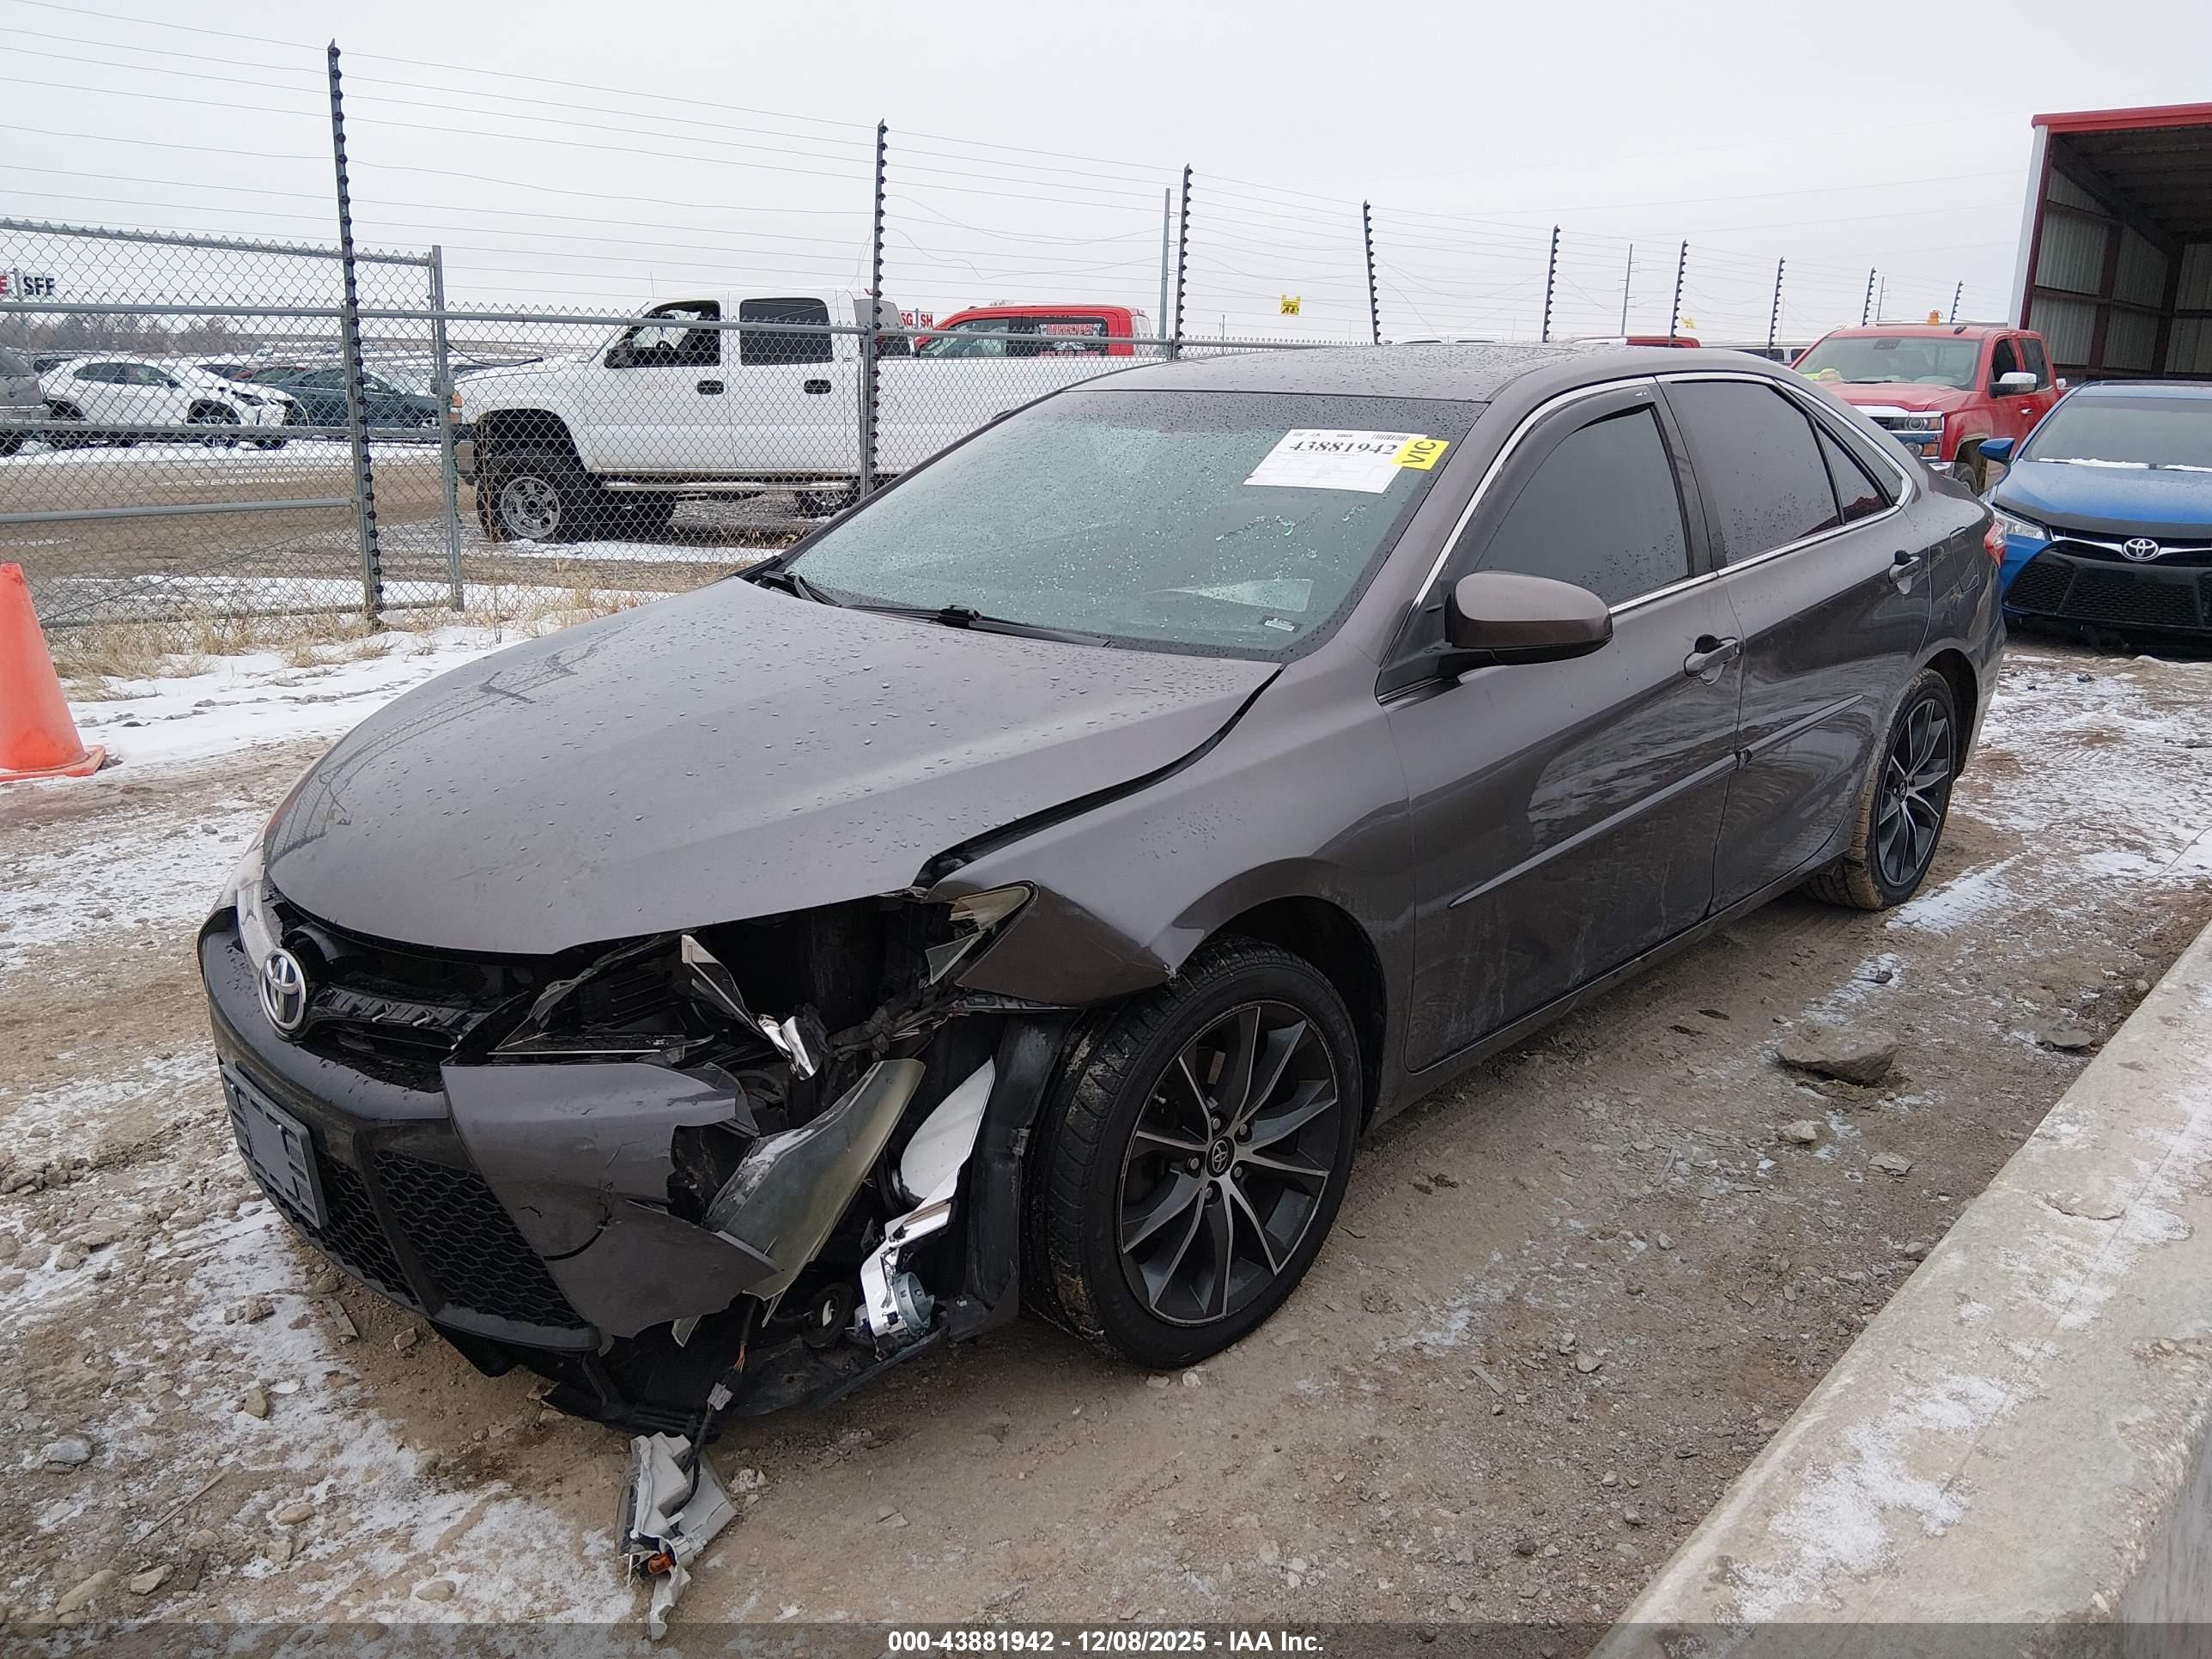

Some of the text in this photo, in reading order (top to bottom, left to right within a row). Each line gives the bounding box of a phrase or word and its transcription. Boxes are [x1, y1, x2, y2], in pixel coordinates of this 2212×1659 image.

[921, 313, 933, 328] SH
[1289, 440, 1398, 455] 43881942
[1401, 440, 1437, 465] VIC
